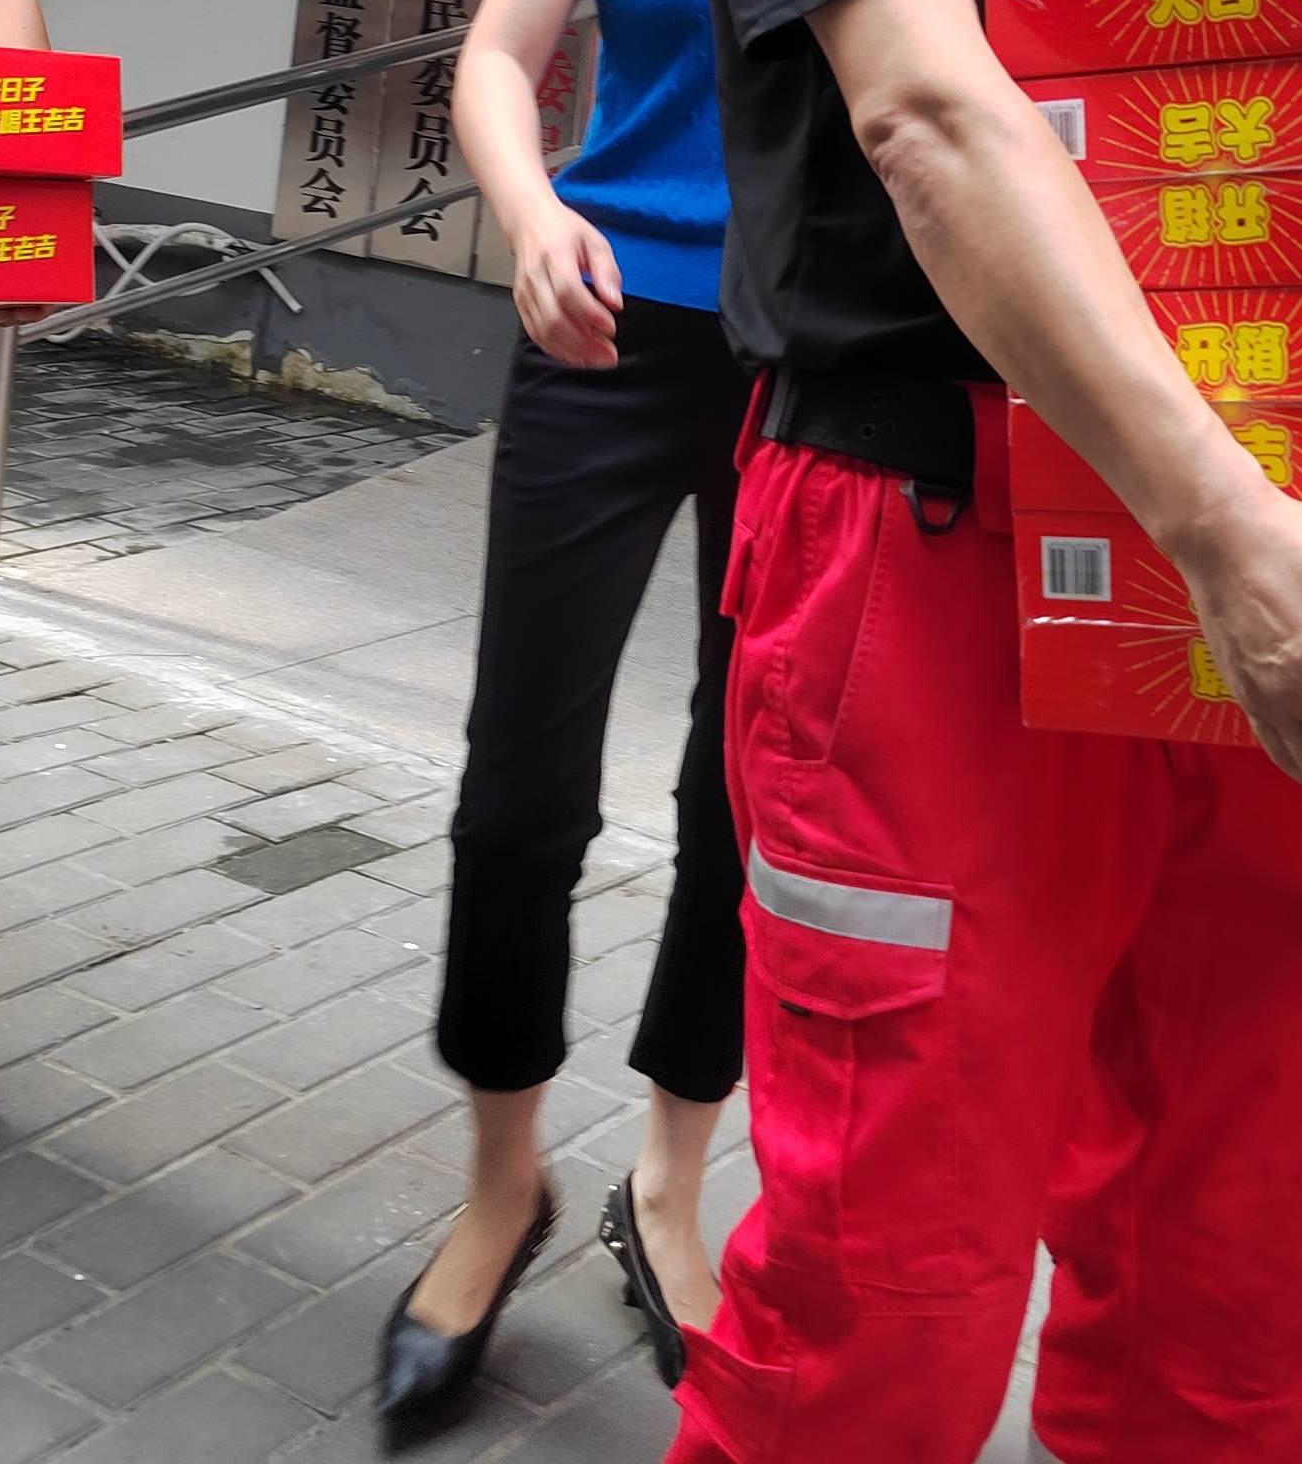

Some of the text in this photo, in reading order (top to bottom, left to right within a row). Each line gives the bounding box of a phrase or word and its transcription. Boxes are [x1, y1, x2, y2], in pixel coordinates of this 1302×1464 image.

[1160, 96, 1276, 165] 大吉
[1159, 182, 1270, 247] 开箱
[1176, 320, 1289, 386] 开箱
